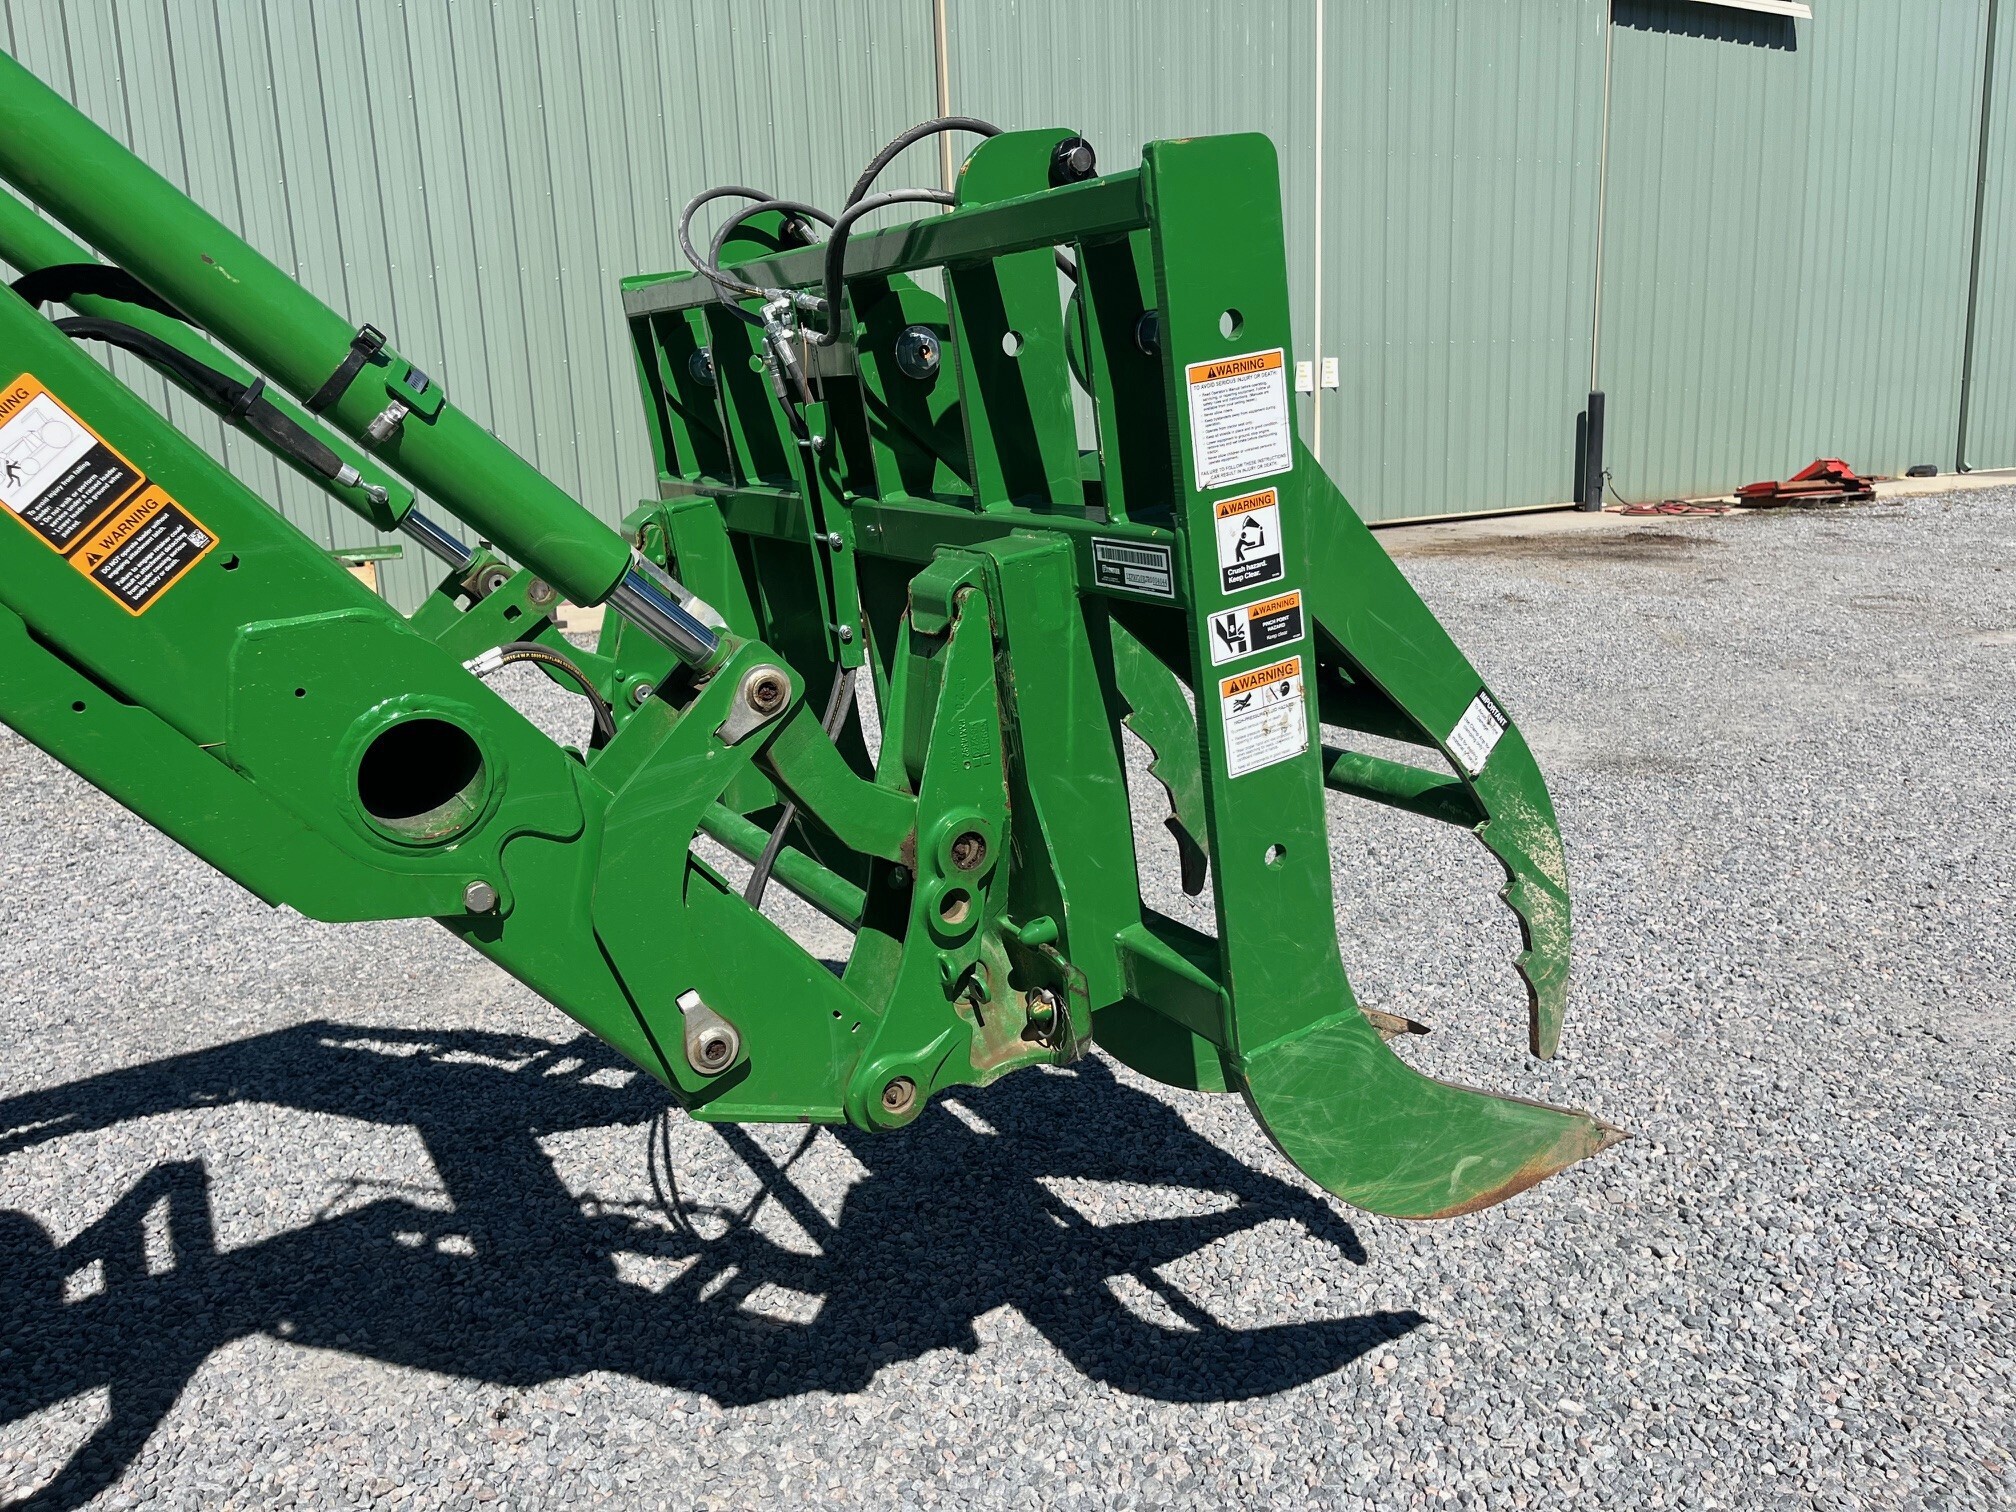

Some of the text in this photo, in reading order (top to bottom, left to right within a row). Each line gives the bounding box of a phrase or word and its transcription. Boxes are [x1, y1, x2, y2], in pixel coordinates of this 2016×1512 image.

[1216, 357, 1264, 376] WARNING
[1216, 378, 1235, 386] SERIOUS
[1201, 468, 1218, 476] FAILURE
[1257, 453, 1285, 463] INSTRUCTIONS
[26, 460, 91, 517] To avoid injury from falling
[42, 473, 98, 523] Do not walk or perform
[48, 509, 68, 527] service
[66, 497, 82, 511] under
[84, 480, 102, 495] raised
[99, 465, 118, 482] loader.
[53, 516, 71, 533] Lower
[69, 503, 87, 519] loader
[90, 482, 110, 500] ground
[107, 471, 124, 485] when
[1228, 494, 1270, 514] WARNING
[60, 518, 82, 538] parked.
[98, 497, 159, 551] WARNING
[100, 512, 169, 574] DO NOT operate loader without
[106, 524, 167, 579] engaging attachment latch.
[115, 570, 133, 586] Failure
[135, 550, 154, 568] engage
[152, 535, 172, 553] retainer
[168, 524, 184, 538] could
[120, 577, 136, 591] result
[138, 550, 166, 575] attachment
[163, 531, 187, 553] detaching
[126, 584, 140, 596] from
[137, 571, 154, 586] loader
[151, 555, 171, 573] causing
[169, 541, 187, 557] serious
[132, 586, 148, 600] bodily
[146, 574, 161, 588] injury
[164, 557, 180, 572] death.
[1227, 559, 1266, 576] Crush hazard.
[1228, 568, 1260, 585] Keep Clear.
[1258, 597, 1294, 614] WARNING
[1262, 614, 1289, 627] PINCH POINT
[1267, 622, 1285, 631] HAZARD
[1239, 663, 1293, 689] WARNING
[1479, 690, 1506, 727] IMPORTANT
